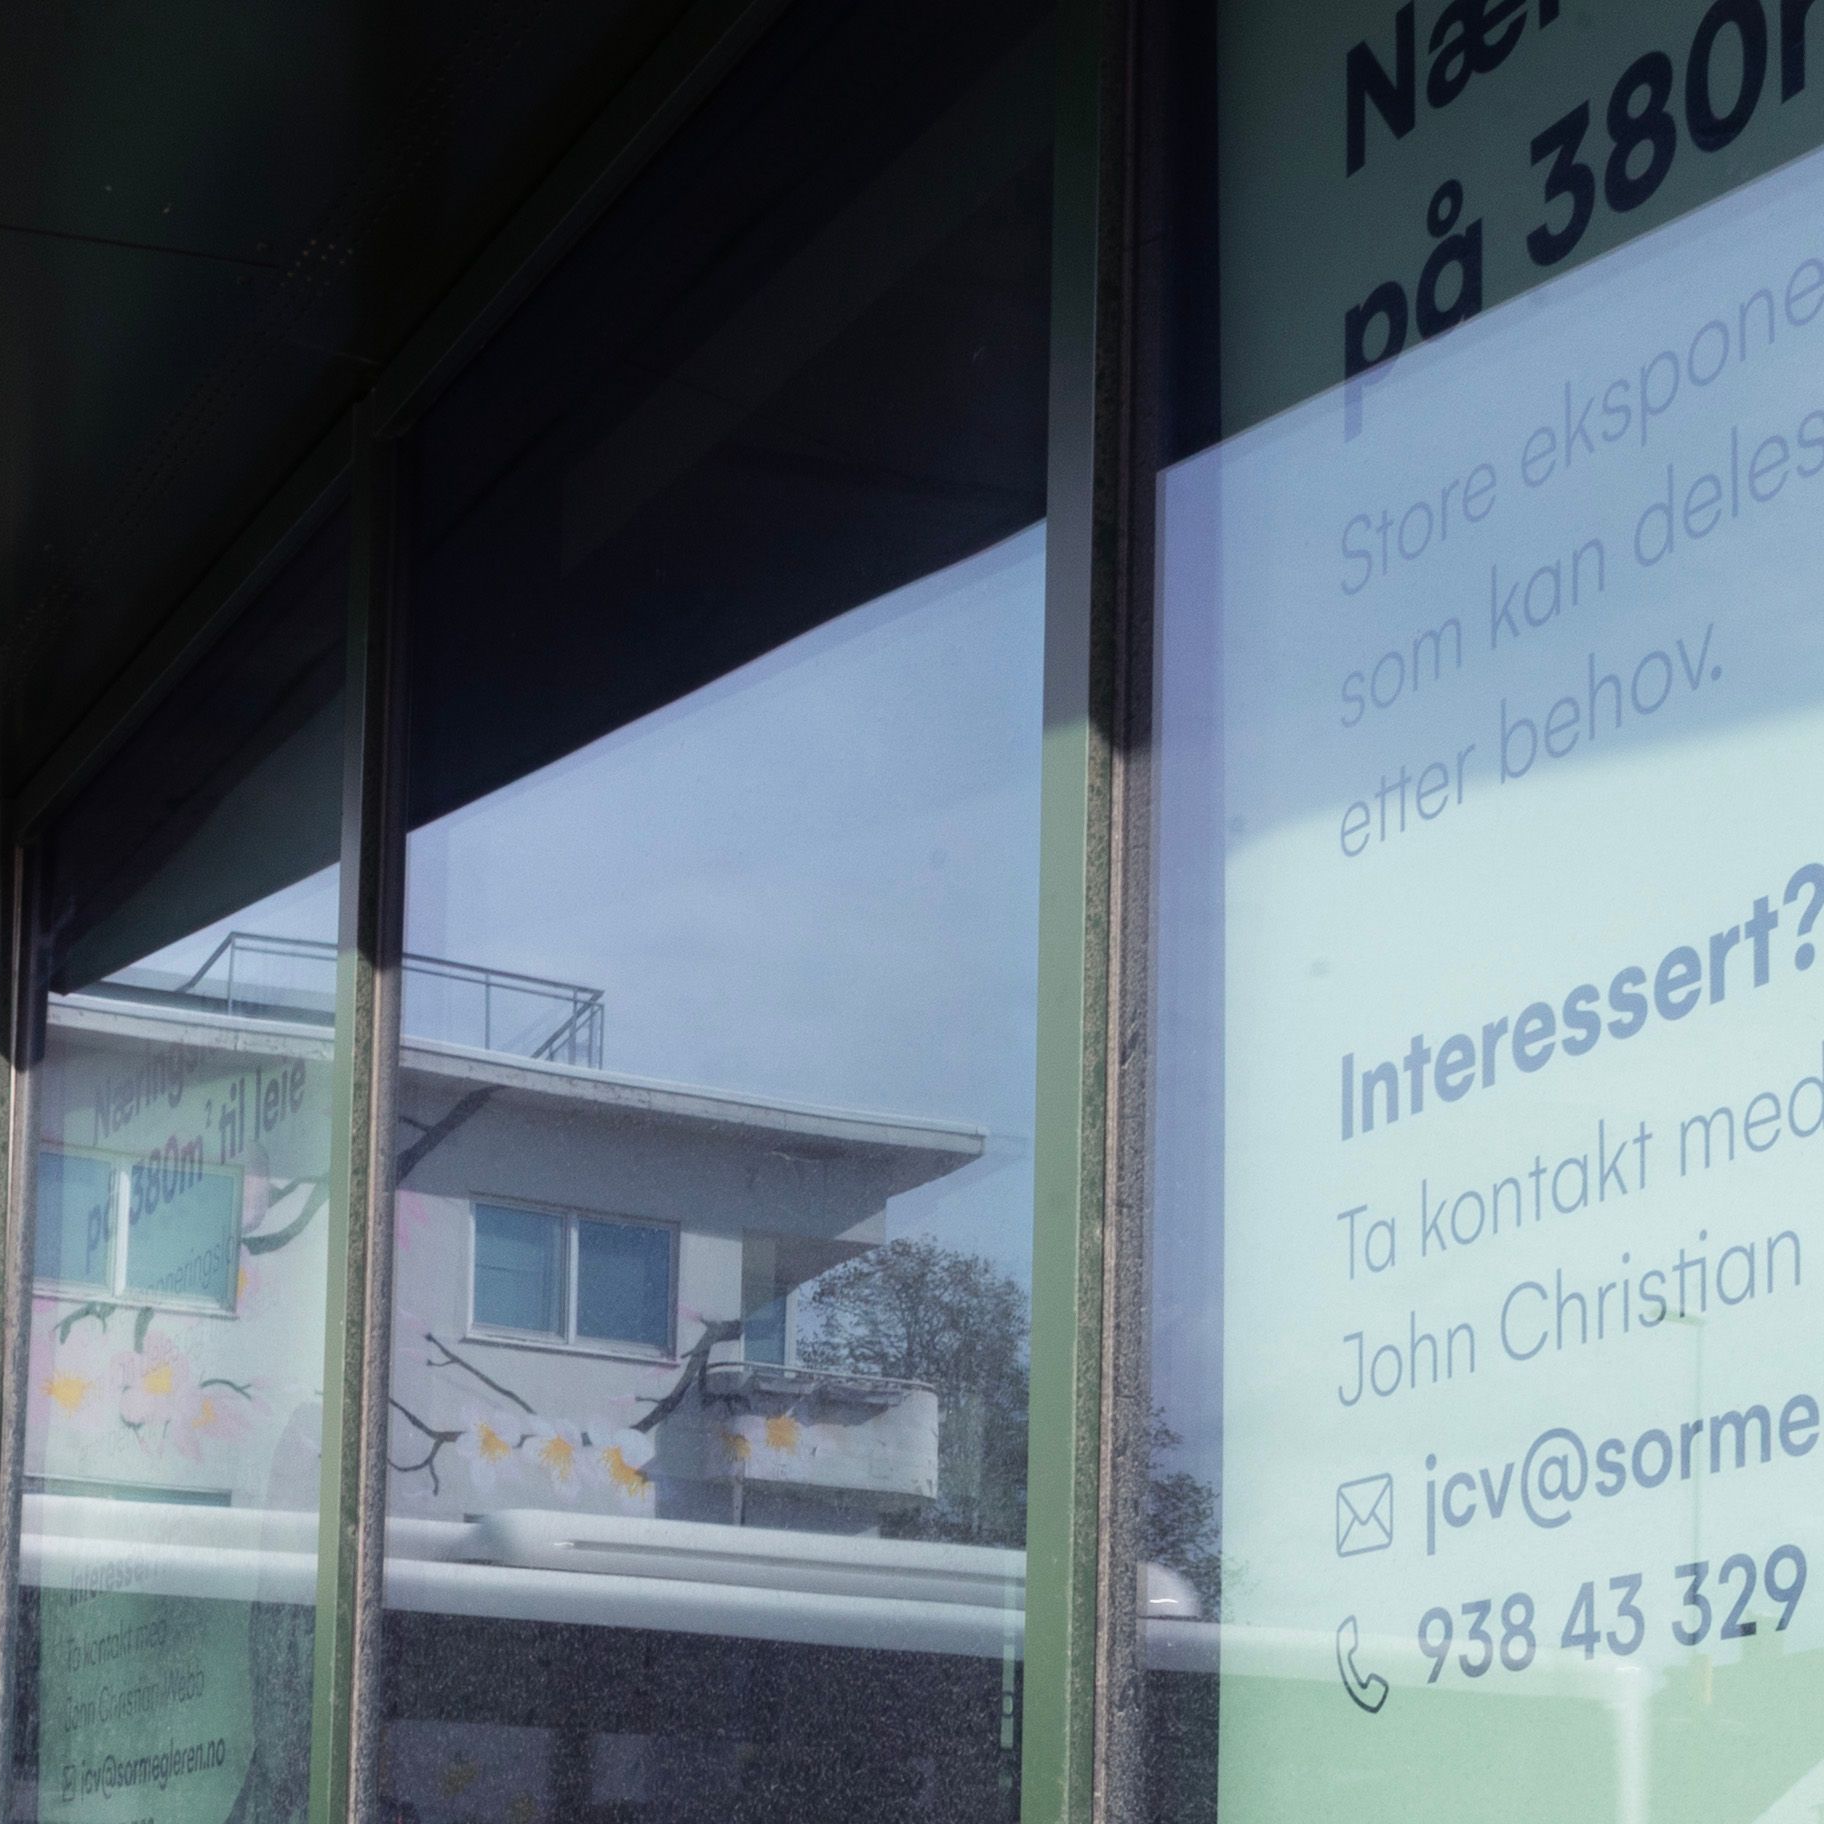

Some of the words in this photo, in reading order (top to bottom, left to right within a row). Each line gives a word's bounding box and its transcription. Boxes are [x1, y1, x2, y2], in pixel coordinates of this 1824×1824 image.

[1344, 180, 1483, 443] på
[1340, 452, 1497, 597] Store
[1338, 619, 1464, 729] som
[1490, 536, 1605, 650] kan
[1338, 740, 1475, 859] etter
[1501, 620, 1723, 785] behov.
[255, 1056, 305, 1140] leie
[1337, 1205, 1398, 1280] Ta
[1421, 1118, 1652, 1258] kontakt
[1337, 1311, 1476, 1408] John
[1500, 1227, 1801, 1365] Christian
[1417, 1592, 1535, 1683] 938
[1560, 1568, 1644, 1661] 43
[1672, 1544, 1808, 1647] 329
[80, 1737, 226, 1801] jcv@sormegleren.no
